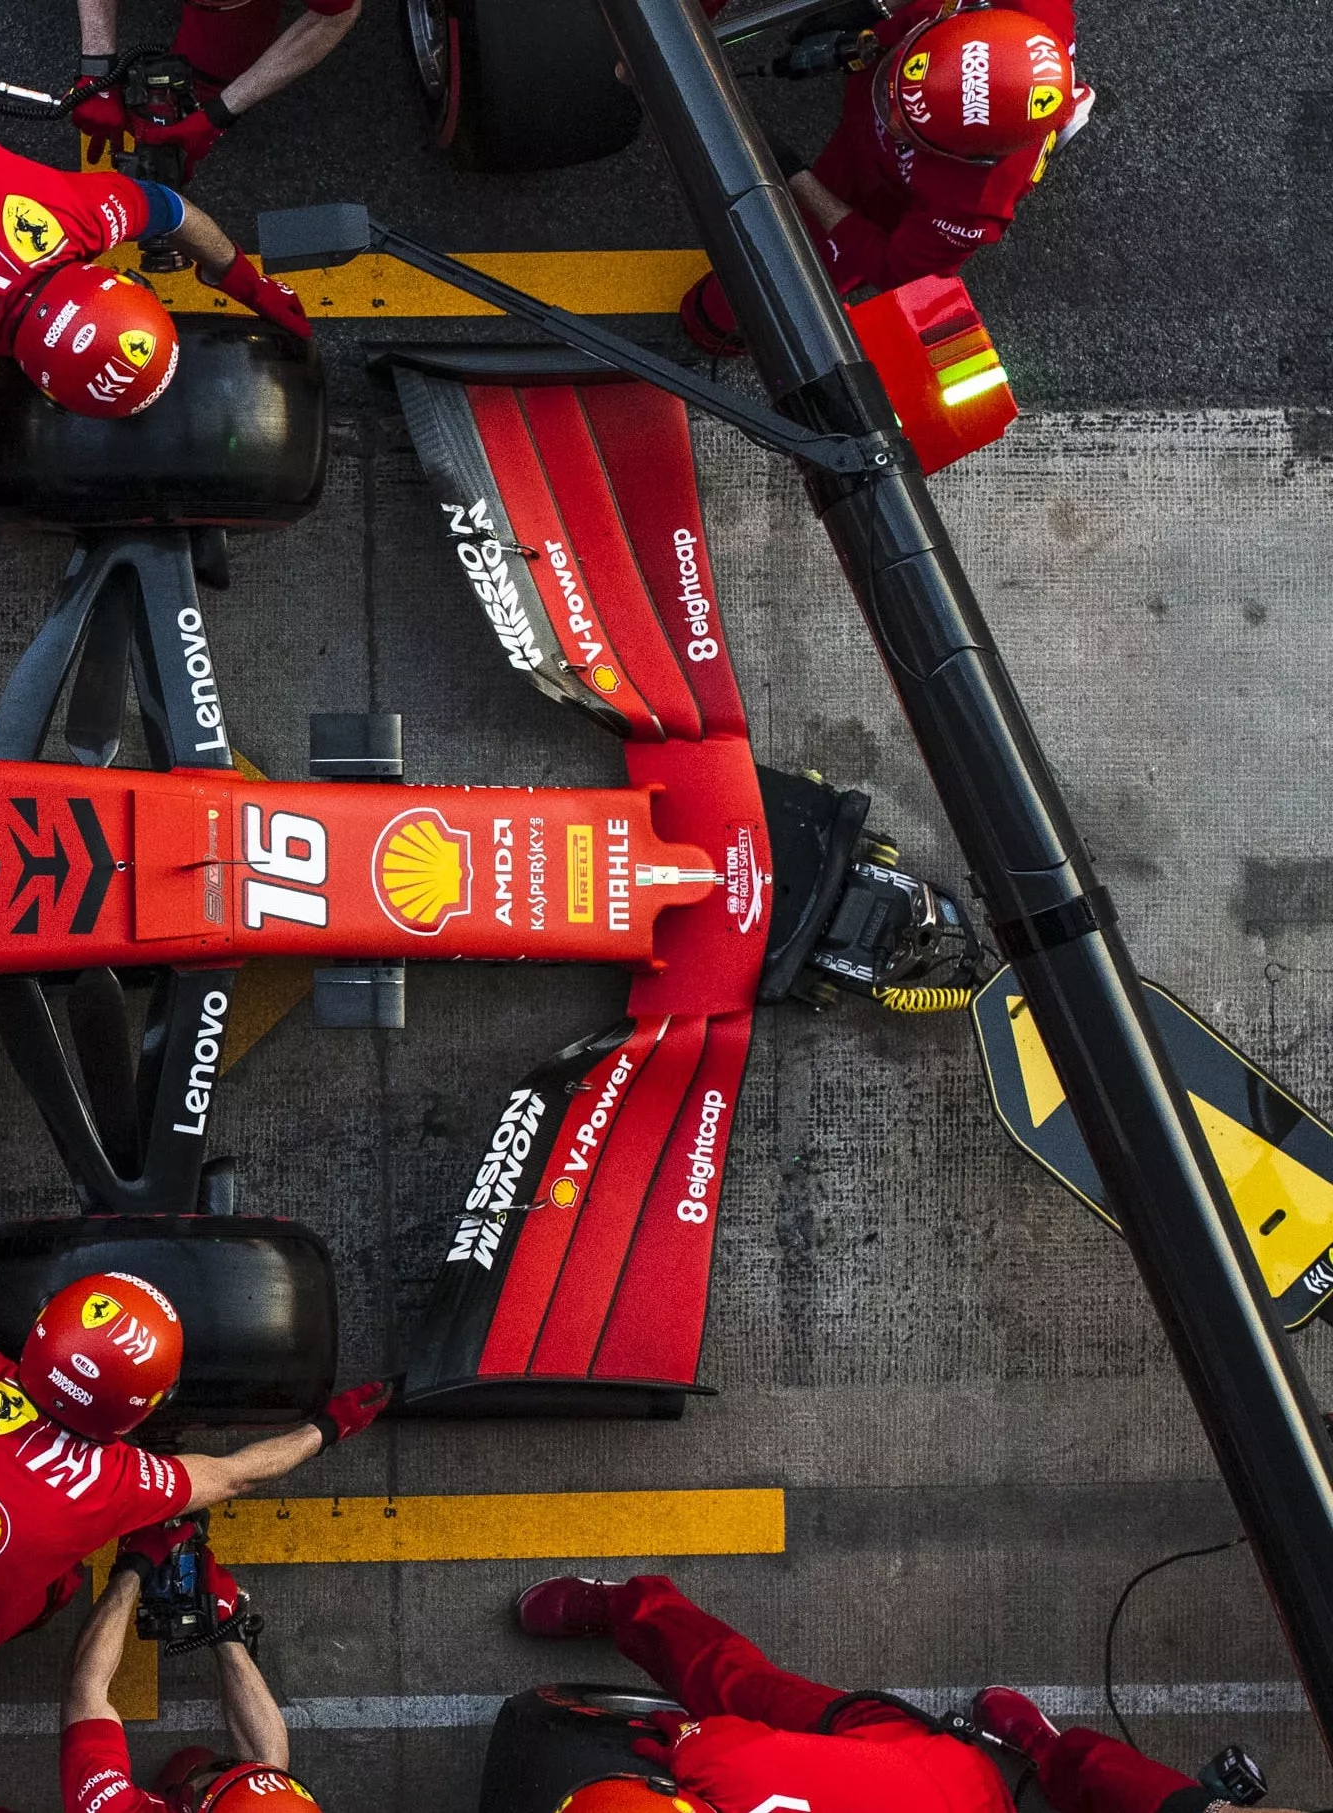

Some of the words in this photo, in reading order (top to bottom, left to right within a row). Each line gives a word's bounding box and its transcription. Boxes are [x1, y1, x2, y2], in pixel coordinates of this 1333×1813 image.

[961, 40, 976, 126] MISSION
[975, 40, 989, 125] WINNOW
[932, 219, 985, 239] HUBLOT
[74, 327, 94, 349] BELL
[441, 502, 533, 671] MISSION
[544, 539, 602, 664] V-Power
[179, 607, 227, 752] Lenovo
[247, 806, 326, 928] 16
[495, 848, 512, 926] AMD
[527, 827, 547, 930] KASPERSKY
[572, 834, 590, 916] PIRELLI
[607, 819, 629, 930] MAHLE
[727, 846, 738, 892] ACTION
[738, 828, 749, 863] SAFETY
[738, 865, 748, 897] ROAD
[738, 899, 747, 914] FOR
[173, 991, 227, 1136] Lenovo
[564, 1054, 633, 1173] V-Power
[446, 1089, 531, 1262] MISSION
[48, 1373, 92, 1406] WINNOW
[51, 1366, 93, 1402] MISSION
[70, 1356, 102, 1377] BELL
